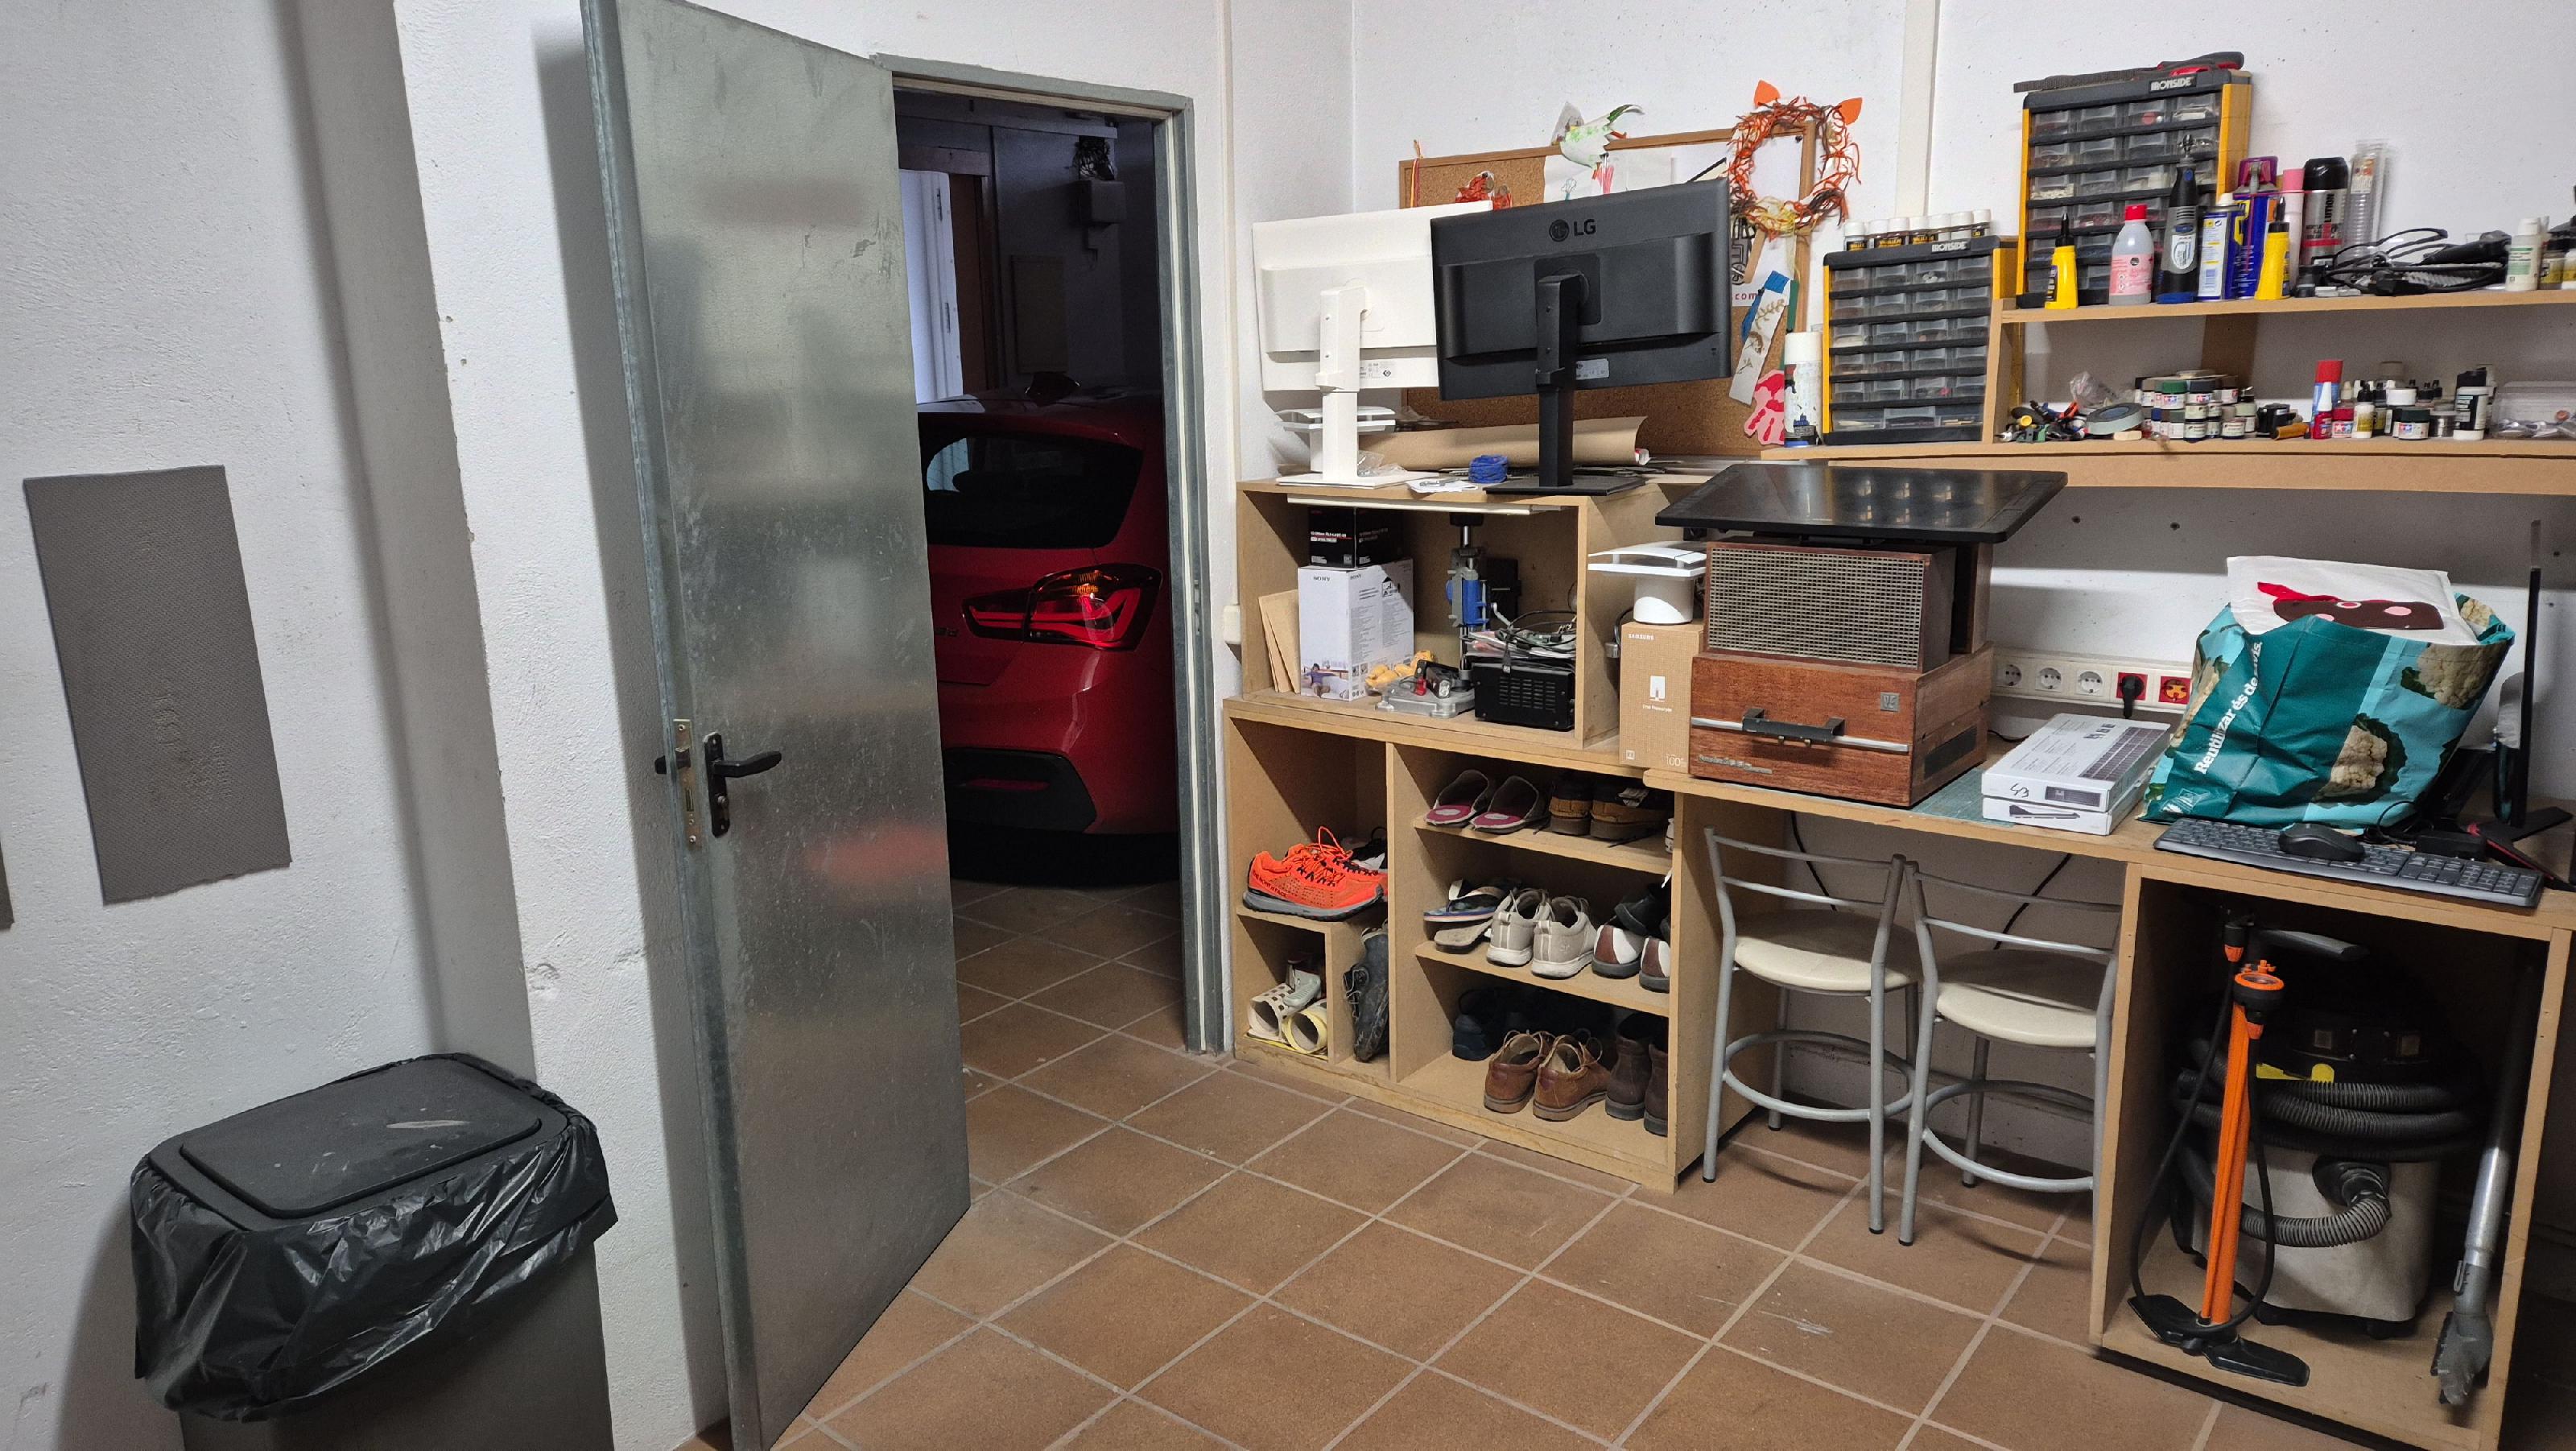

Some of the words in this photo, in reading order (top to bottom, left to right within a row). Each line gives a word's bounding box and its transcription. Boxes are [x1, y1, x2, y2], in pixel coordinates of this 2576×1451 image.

[1573, 218, 1596, 237] LG
[2194, 708, 2236, 775] Reutilizar
[2232, 693, 2248, 711] és
[2243, 677, 2258, 696] de
